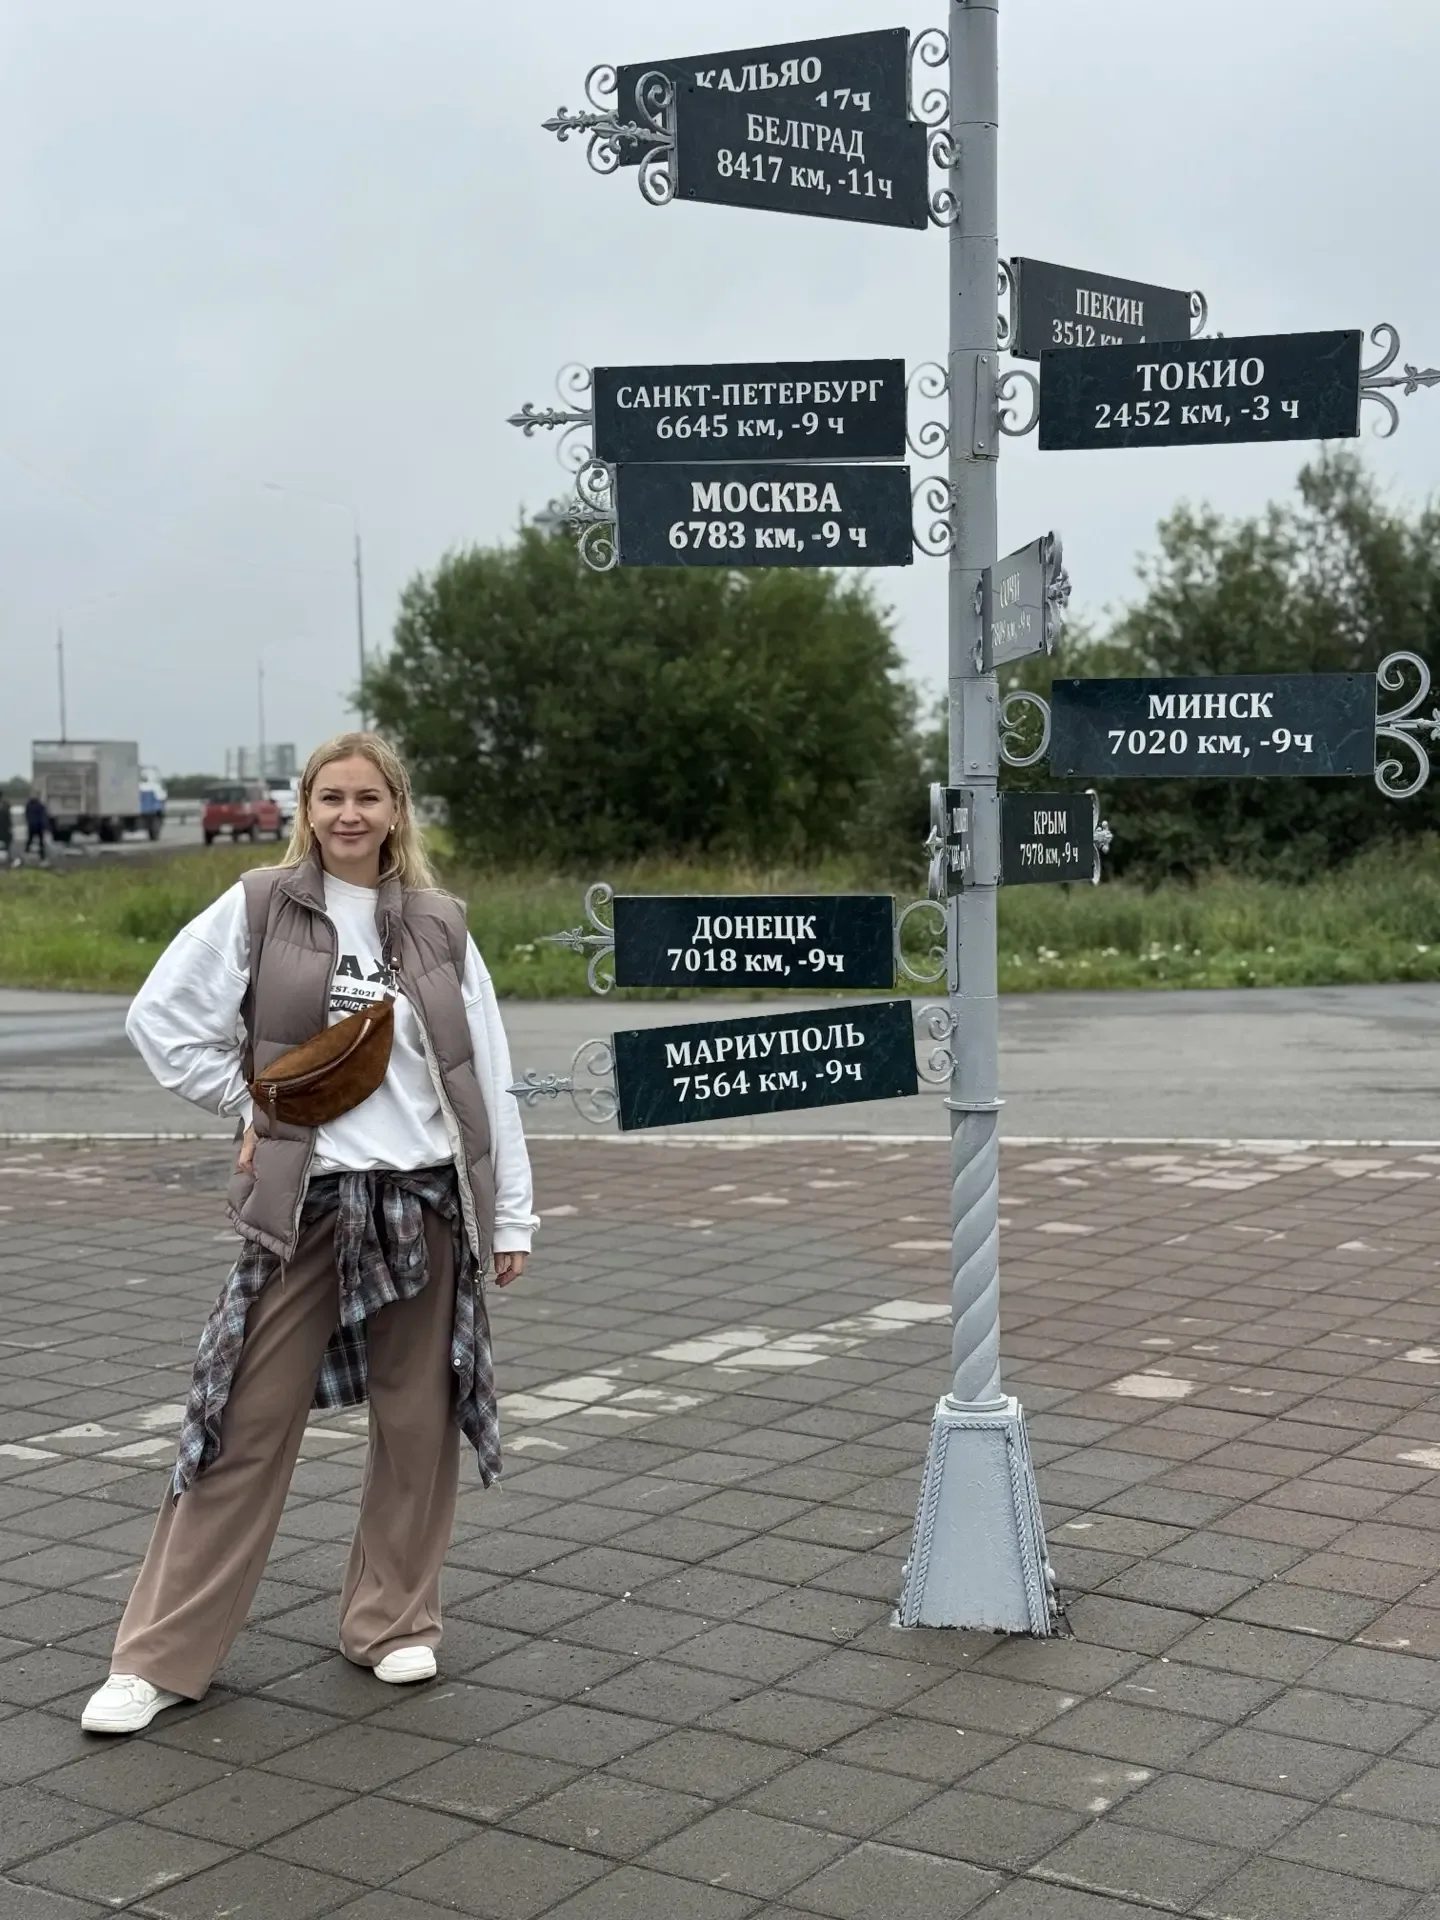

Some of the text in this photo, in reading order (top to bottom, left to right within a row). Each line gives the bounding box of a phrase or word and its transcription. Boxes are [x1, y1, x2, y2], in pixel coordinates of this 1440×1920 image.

[694, 55, 823, 94] КАЛЬЯО
[746, 112, 866, 164] БЕЛГРАД
[717, 148, 893, 200] 8417 км, -11ч
[1075, 287, 1145, 328] ПЕКИН
[1051, 318, 1097, 348] 3512
[1136, 357, 1265, 392] ТОКИО
[616, 379, 884, 409] САНКТ-ПЕТЕРБУРГ
[656, 411, 845, 440] 6645 км, -9 ч
[1094, 394, 1300, 429] 2452 км, -3 ч
[690, 481, 843, 513] МОСКВА
[668, 520, 867, 553] 6783 км, -9 ч
[1147, 692, 1274, 720] МИНСК
[1107, 727, 1314, 758] 7020 км, -9ч
[1033, 810, 1067, 835] КРЫМ
[1019, 842, 1044, 866] 7978
[1045, 847, 1061, 868] км,
[691, 915, 817, 945] ДОНЕЦК
[667, 948, 845, 977] 7018 км, -9ч
[351, 987, 376, 998] 2021
[663, 1022, 866, 1069] МАРИУПОЛЬ
[671, 1059, 863, 1103] 7564 км, -9ч
